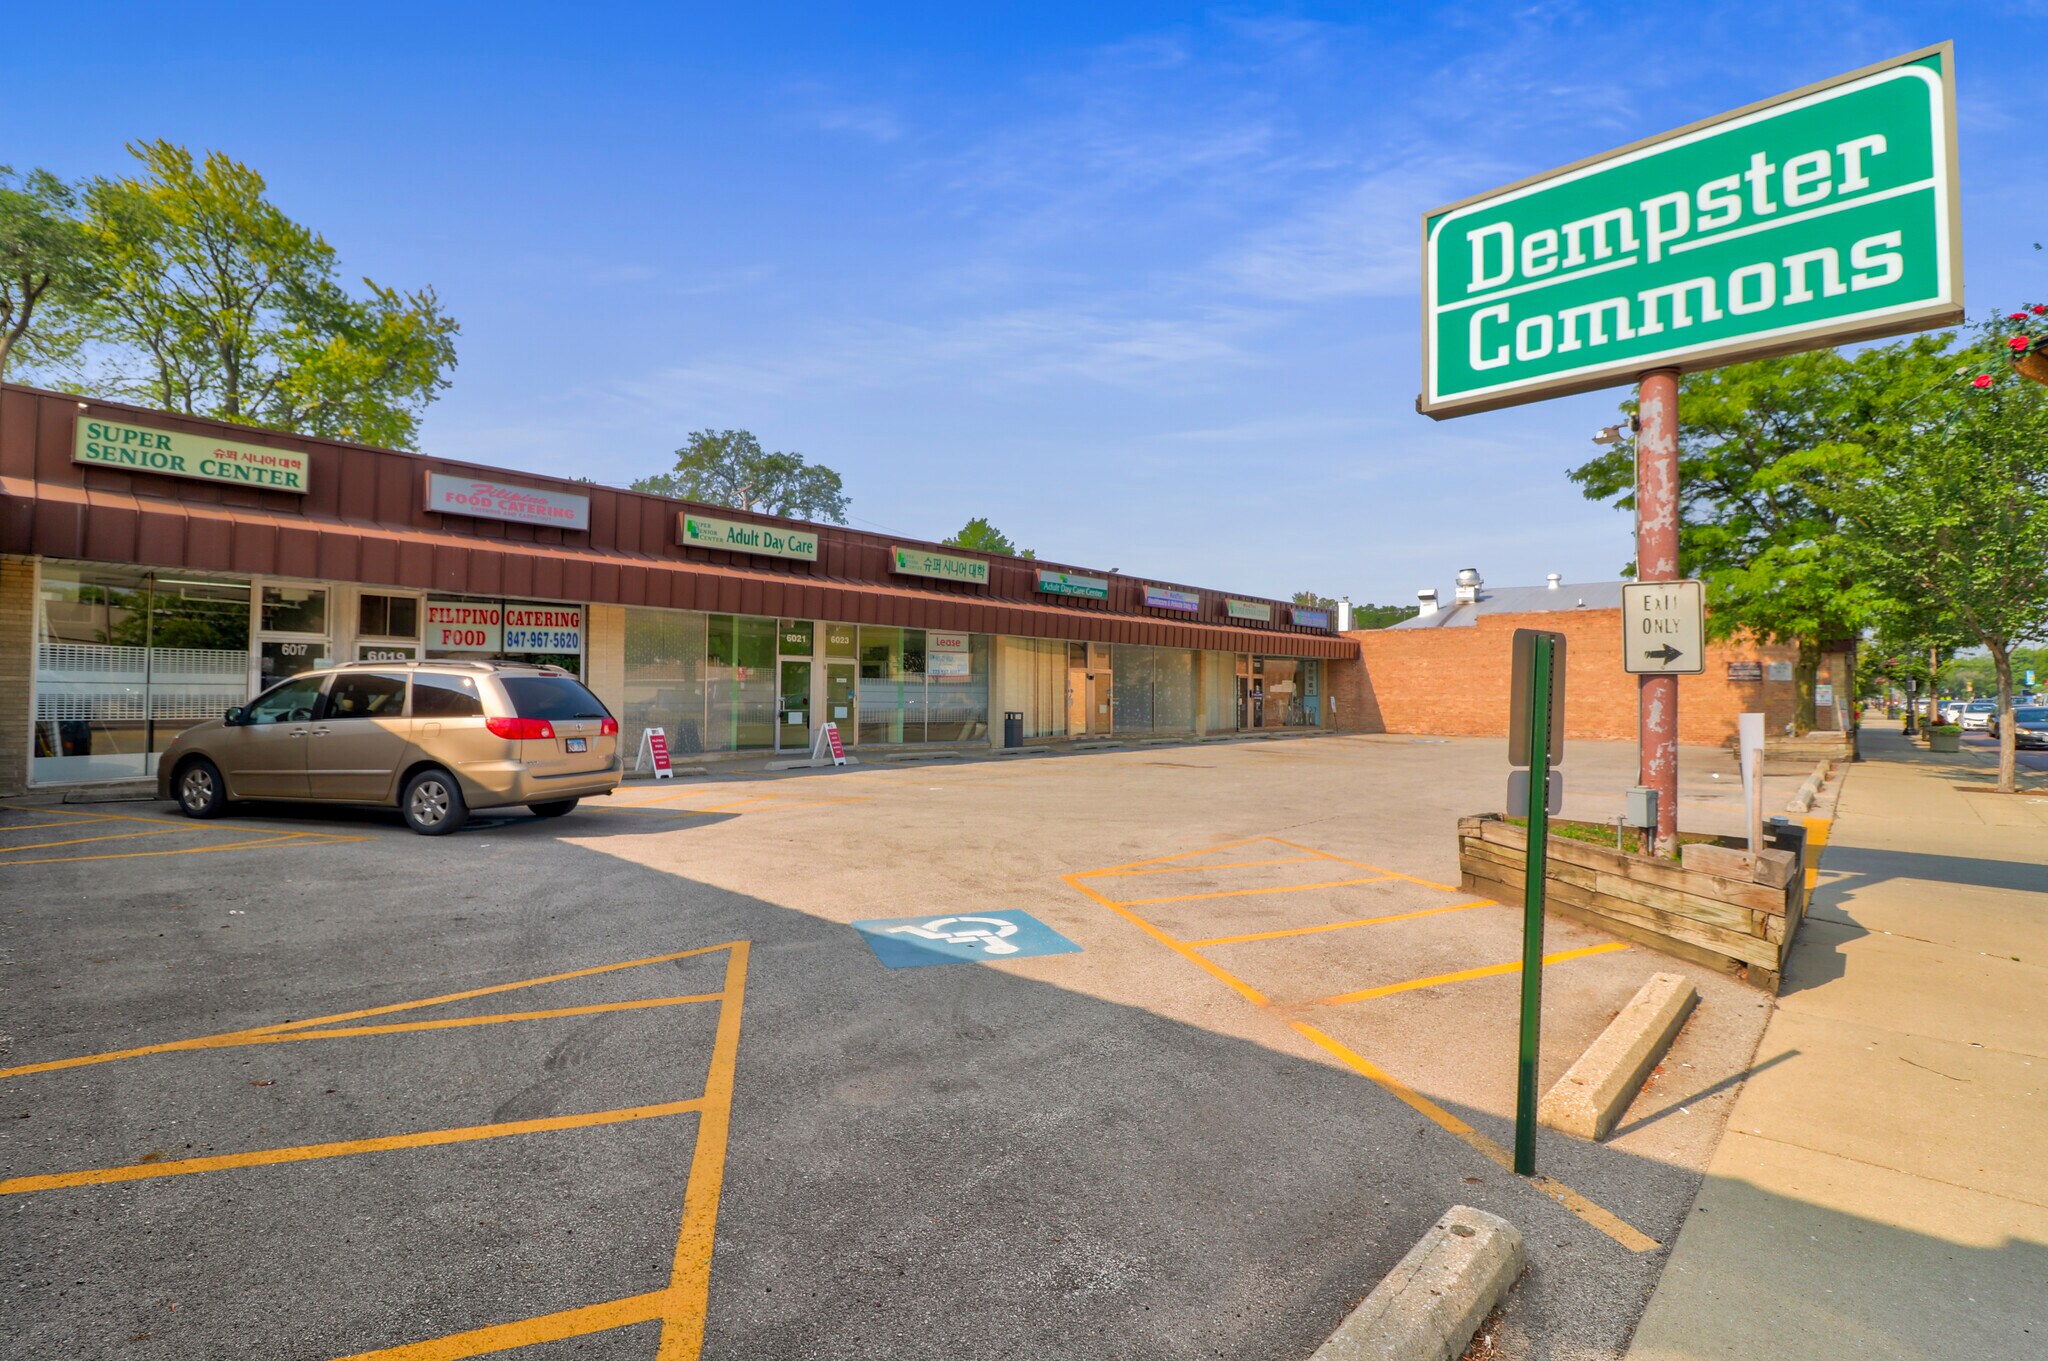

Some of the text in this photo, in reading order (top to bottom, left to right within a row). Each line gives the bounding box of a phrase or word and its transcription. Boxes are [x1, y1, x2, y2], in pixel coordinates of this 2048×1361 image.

[1466, 133, 1887, 293] Dempster
[1468, 230, 1904, 371] Commons
[87, 422, 172, 451] SUPER
[86, 442, 300, 488] SENIOR CENTER
[213, 448, 302, 470] 슈퍼 시니어 대학
[470, 483, 549, 506] Filipino
[446, 492, 575, 519] FOOD CATERING
[726, 526, 813, 554] Adult Day Care
[924, 556, 985, 579] 슈퍼 시니어 대학
[1043, 582, 1103, 597] Adult Day Care Center
[428, 607, 580, 628] FILIPINO CATERING
[1643, 617, 1680, 634] ONLY
[442, 629, 486, 646] FOOD
[507, 631, 579, 649] 847-967-5620
[786, 634, 806, 643] 6021
[830, 635, 849, 645] 6023
[936, 637, 961, 647] Lease
[281, 643, 308, 656] 6017
[367, 651, 406, 661] 6019
